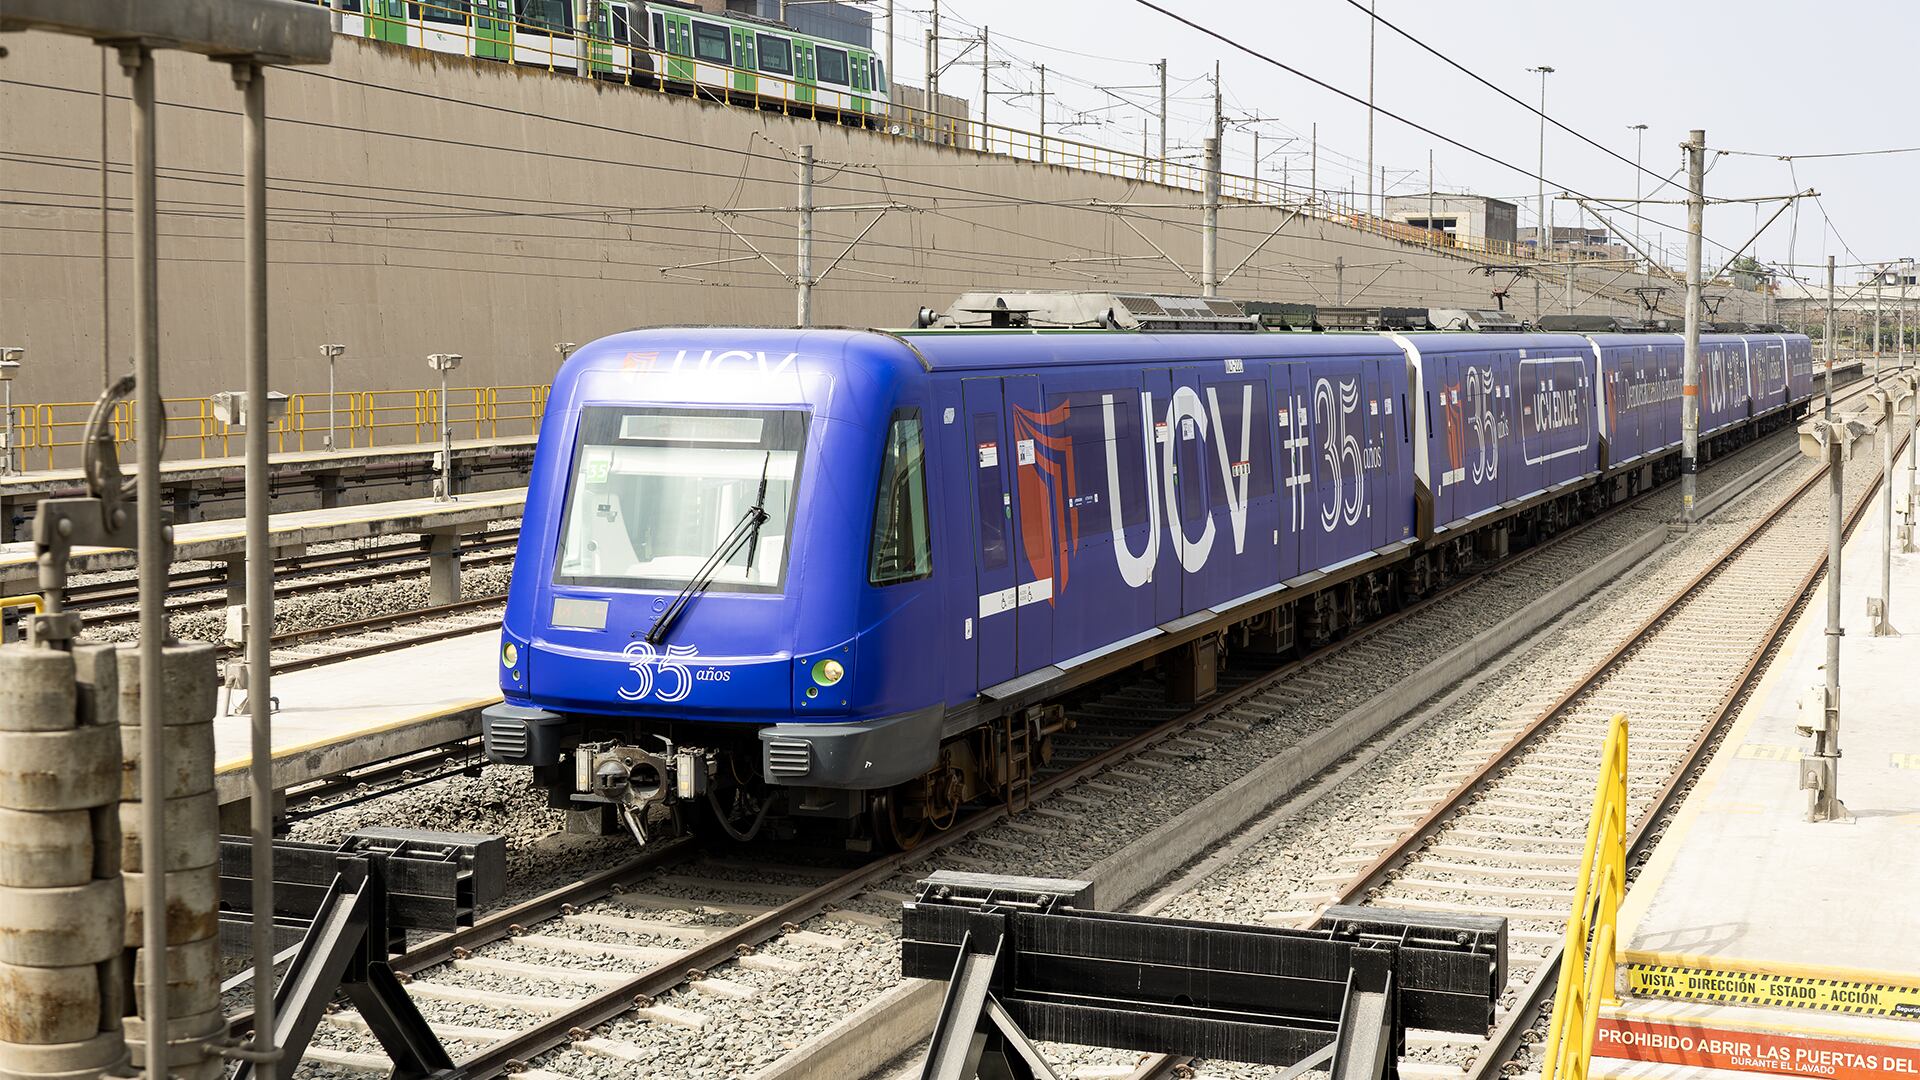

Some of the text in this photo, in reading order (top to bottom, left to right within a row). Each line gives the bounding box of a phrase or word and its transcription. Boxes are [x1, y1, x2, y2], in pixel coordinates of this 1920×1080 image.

[1533, 389, 1578, 432] UCV.EDU.PE
[587, 464, 607, 479] 35
[1102, 384, 1253, 588] UCV
[617, 641, 731, 702] 35 años
[1641, 974, 1675, 987] VISTA
[1688, 977, 1756, 994] DIRECCIÓN
[1770, 984, 1817, 999] ESTADO
[1599, 1029, 1919, 1074] PROHIBIDO ABRIR LAS PUERTAS DEL
[1731, 1056, 1835, 1075] DURANTE EL LAVADO
